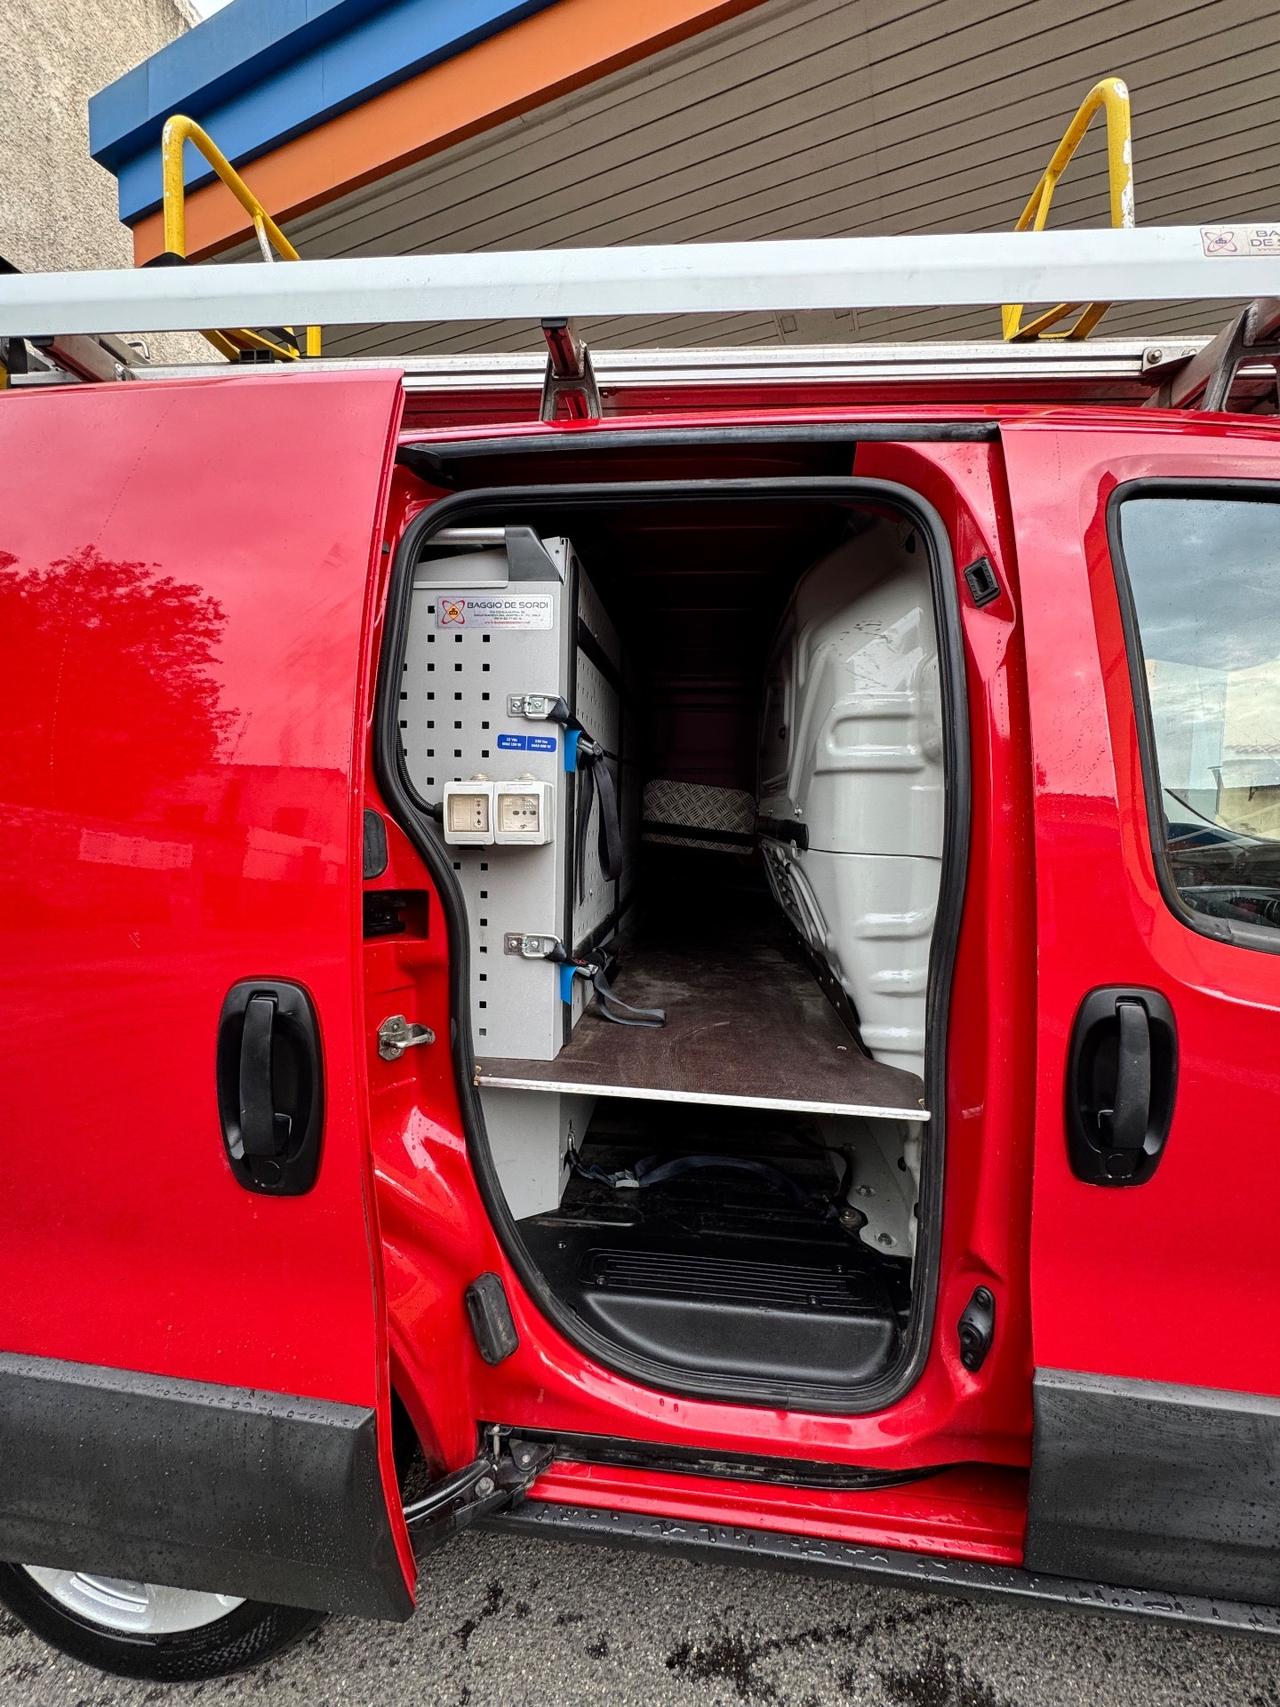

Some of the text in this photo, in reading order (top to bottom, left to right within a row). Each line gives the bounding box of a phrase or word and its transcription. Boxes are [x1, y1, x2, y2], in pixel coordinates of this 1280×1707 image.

[1250, 239, 1274, 247] DE
[467, 601, 549, 609] BAGGIO DE SORDI
